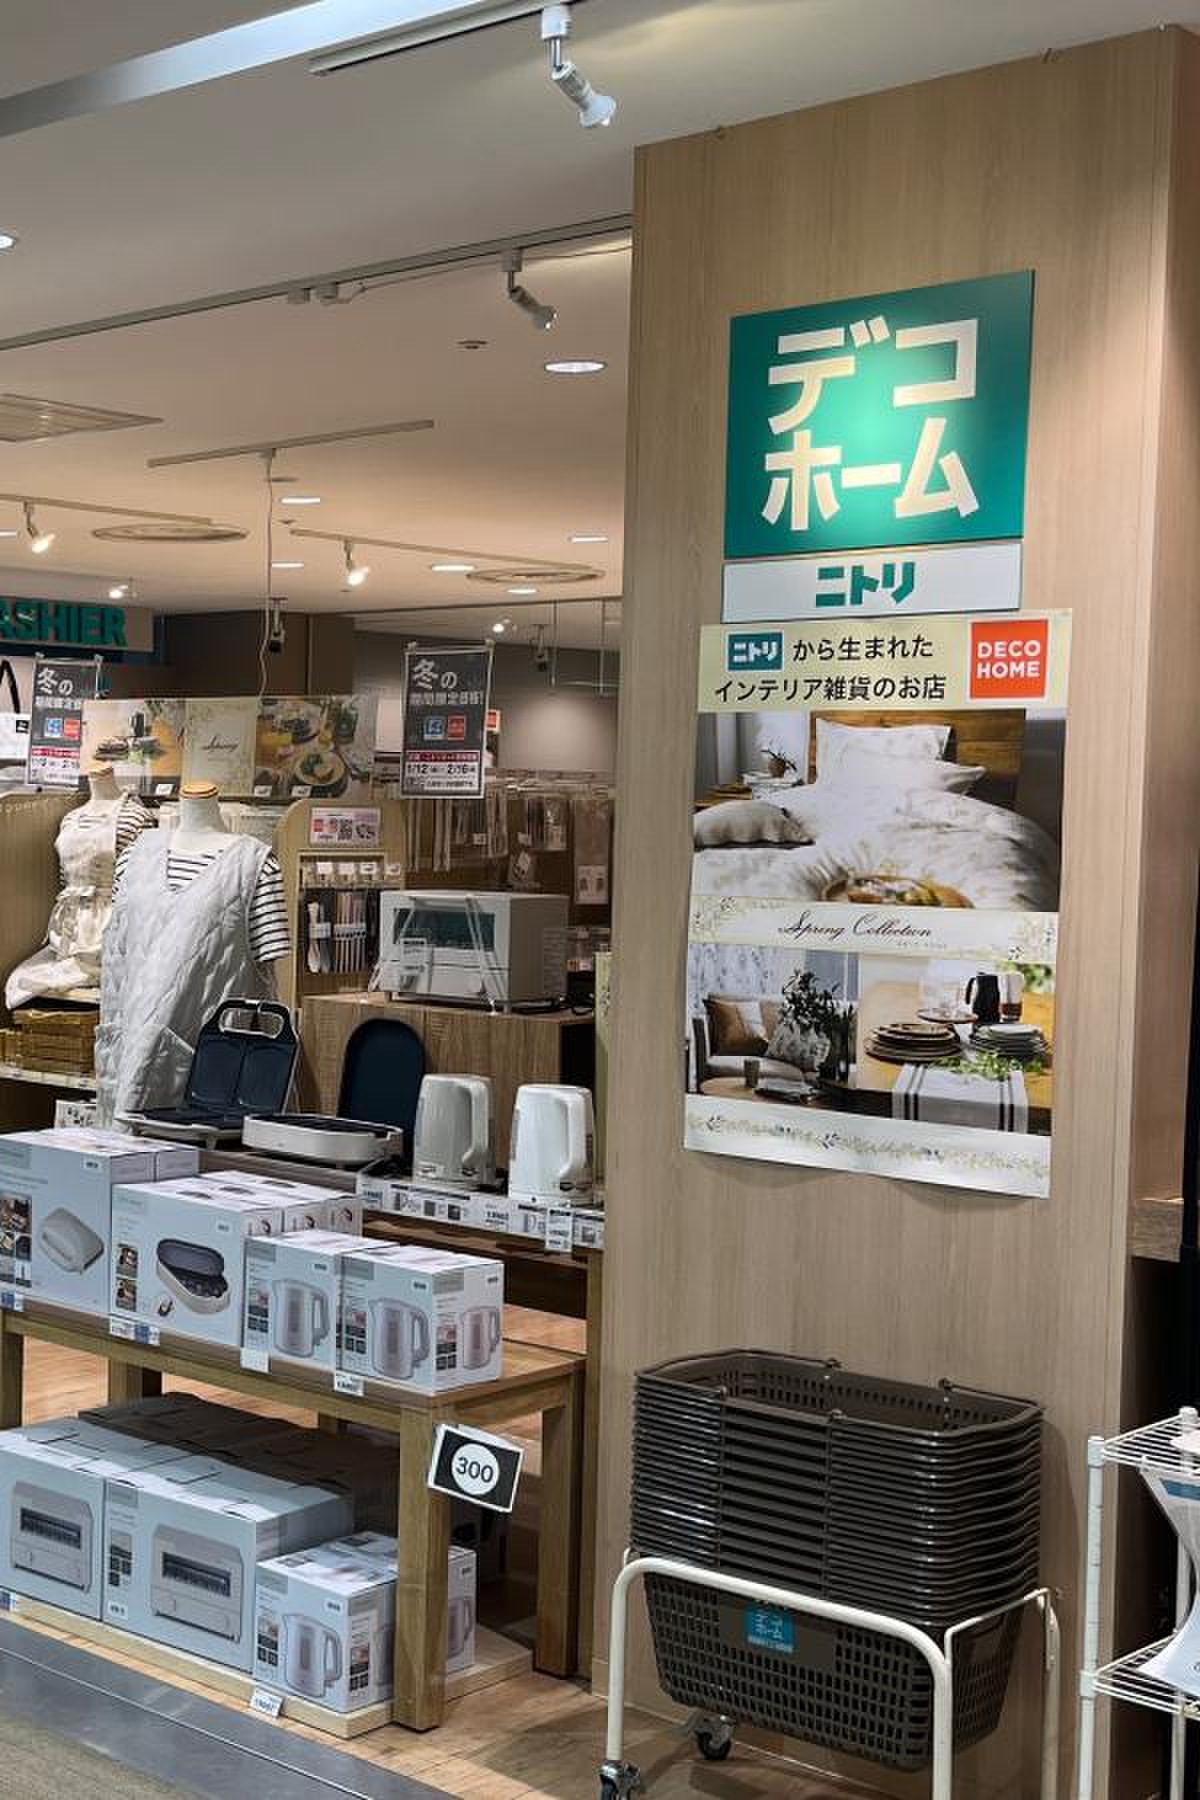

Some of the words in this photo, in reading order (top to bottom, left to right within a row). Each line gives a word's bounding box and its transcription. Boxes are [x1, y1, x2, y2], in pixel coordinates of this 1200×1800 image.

[767, 314, 979, 435] デコ
[761, 417, 980, 531] ホーム
[815, 561, 916, 608] ニトリ
[732, 639, 778, 662] ニトリ
[792, 634, 934, 662] から生まれた
[977, 639, 1041, 659] DECO
[37, 667, 74, 696] 冬の
[413, 658, 458, 690] 冬の
[976, 660, 1040, 679] HOME
[714, 674, 948, 702] インテリア雑貨のお店
[778, 909, 846, 941] Spring
[852, 911, 932, 938] Collection
[455, 1456, 494, 1484] 300
